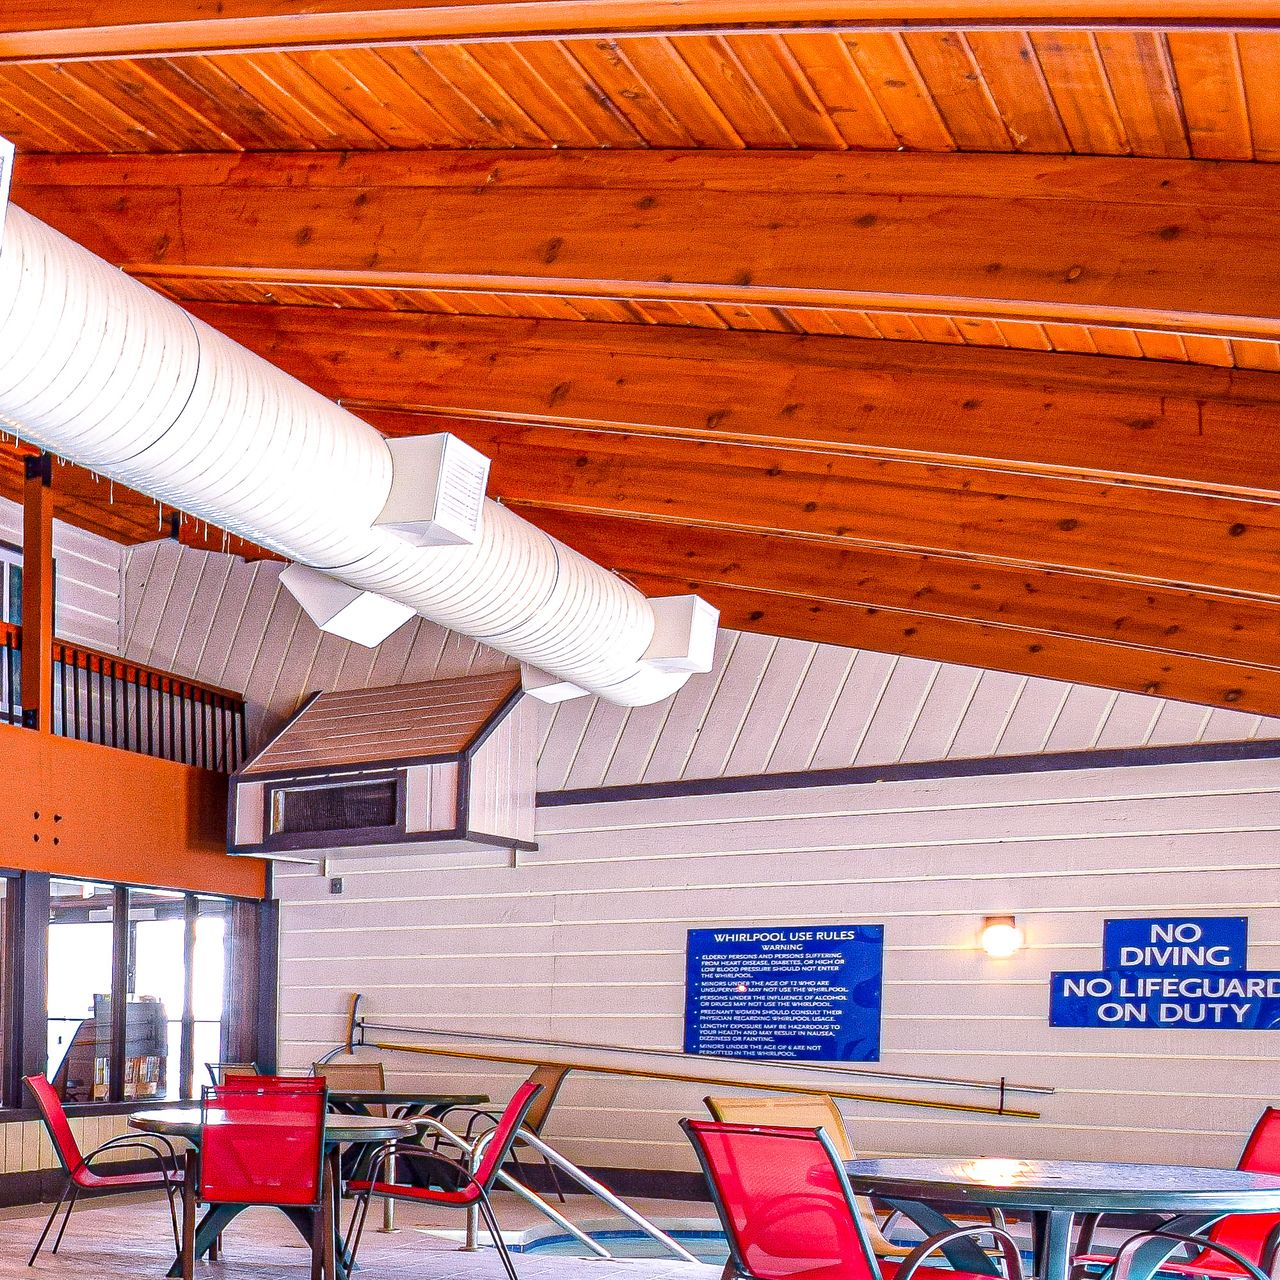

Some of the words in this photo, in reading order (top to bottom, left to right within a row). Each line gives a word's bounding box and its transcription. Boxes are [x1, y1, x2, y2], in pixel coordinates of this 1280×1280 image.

[714, 932, 787, 942] WHIRLPOOL
[789, 931, 813, 941] USE
[816, 931, 855, 940] RULES
[1150, 923, 1202, 943] NO
[761, 943, 804, 951] WARNING
[1120, 946, 1230, 967] DIVING
[1063, 978, 1112, 998] NO
[1119, 978, 1280, 998] LIFEGUARD
[1097, 1003, 1146, 1022] ON
[1159, 1003, 1252, 1023] DUTY
